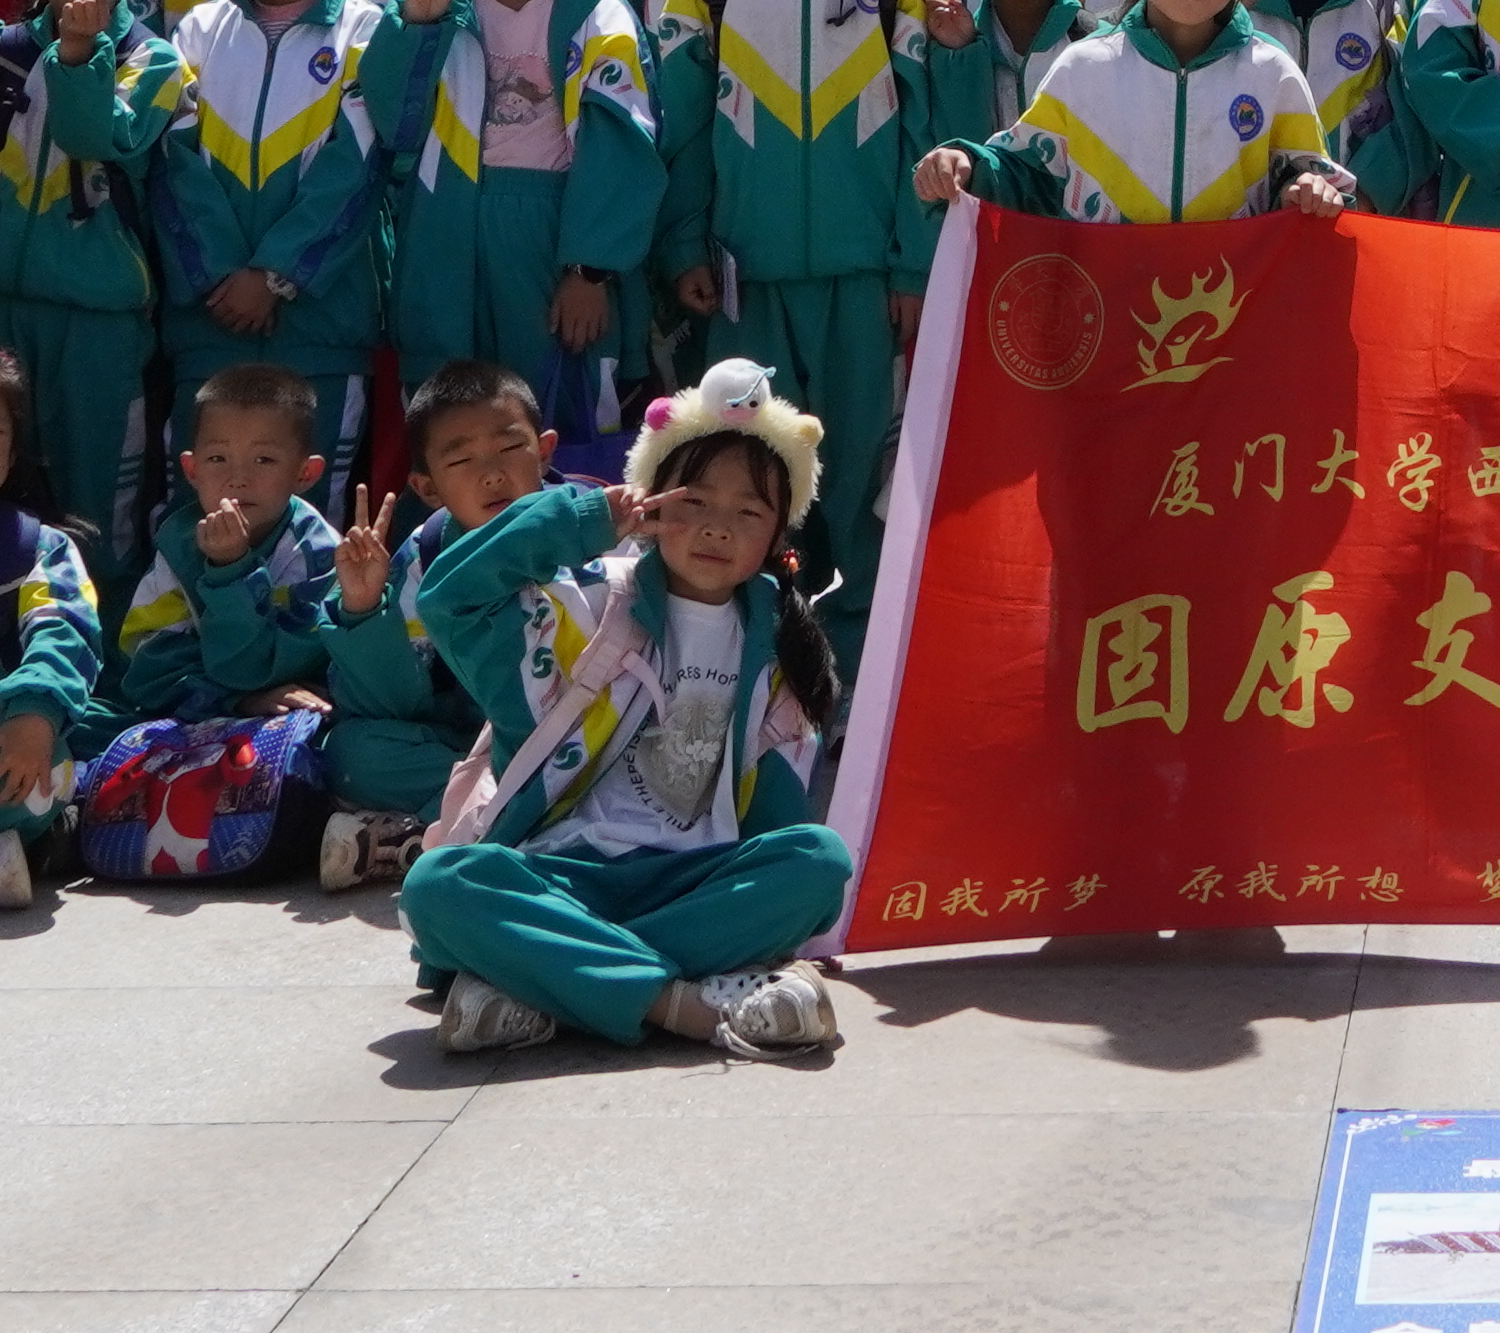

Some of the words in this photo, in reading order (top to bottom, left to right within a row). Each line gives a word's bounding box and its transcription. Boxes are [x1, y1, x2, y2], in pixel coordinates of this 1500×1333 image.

[882, 873, 1108, 923] 固我所梦
[1178, 861, 1405, 904] 原我所想
